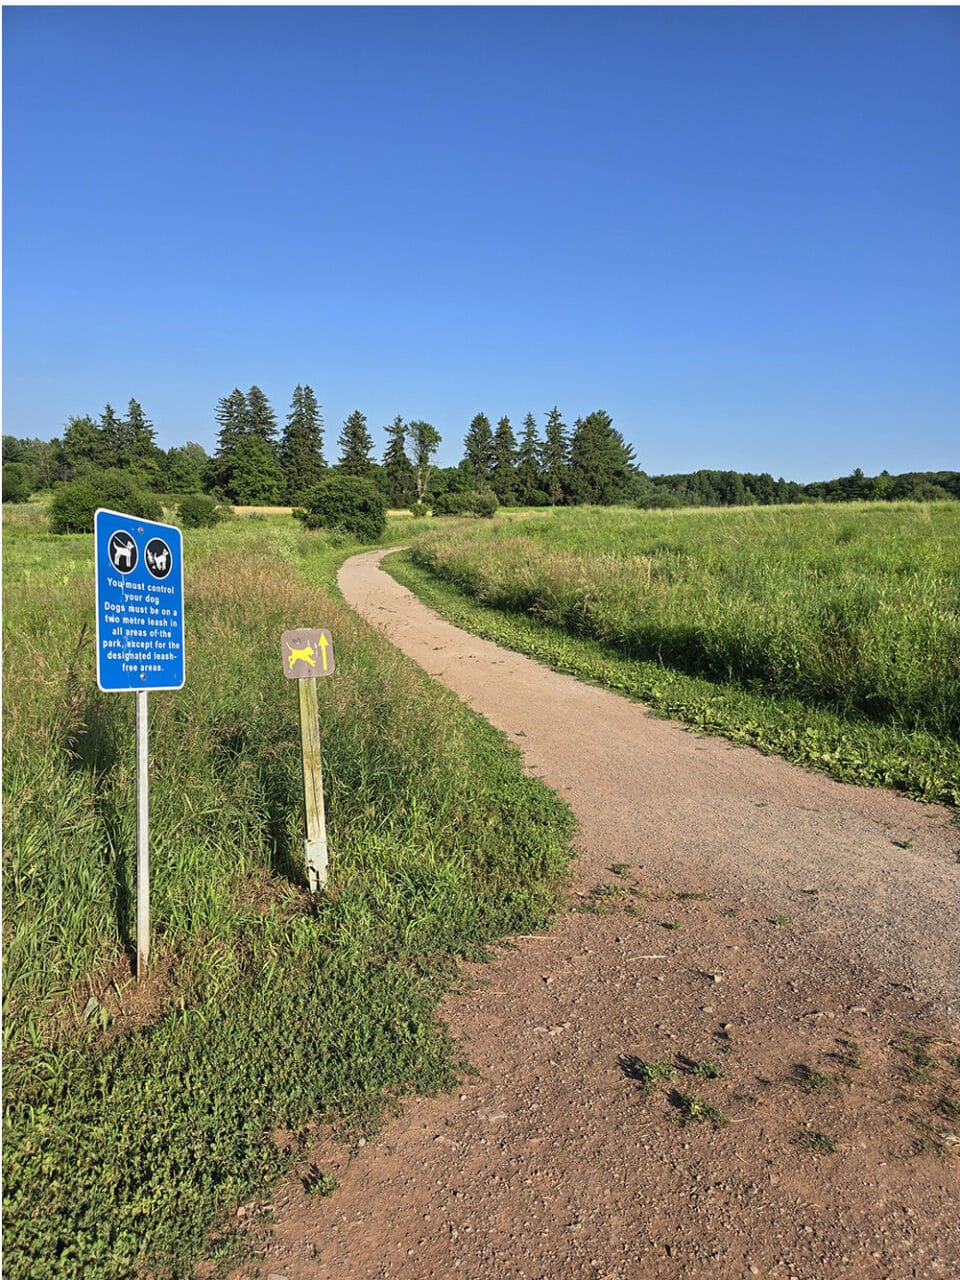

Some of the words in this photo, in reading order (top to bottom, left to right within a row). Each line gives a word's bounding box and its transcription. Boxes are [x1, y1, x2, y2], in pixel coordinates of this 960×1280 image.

[107, 577, 122, 588] You
[125, 582, 144, 591] must
[148, 584, 174, 594] control
[125, 593, 142, 602] your
[145, 595, 159, 605] dog
[104, 602, 125, 614] Dogs
[129, 605, 147, 614] must
[105, 615, 120, 624] two
[123, 617, 145, 625] metre
[148, 617, 167, 627] leash
[150, 629, 158, 637] of
[159, 629, 171, 638] the
[103, 640, 124, 649] park,
[127, 641, 152, 650] except
[155, 640, 166, 649] for
[168, 641, 179, 649] the
[107, 651, 151, 662] designated
[154, 652, 177, 660] leash-
[122, 664, 137, 672] free
